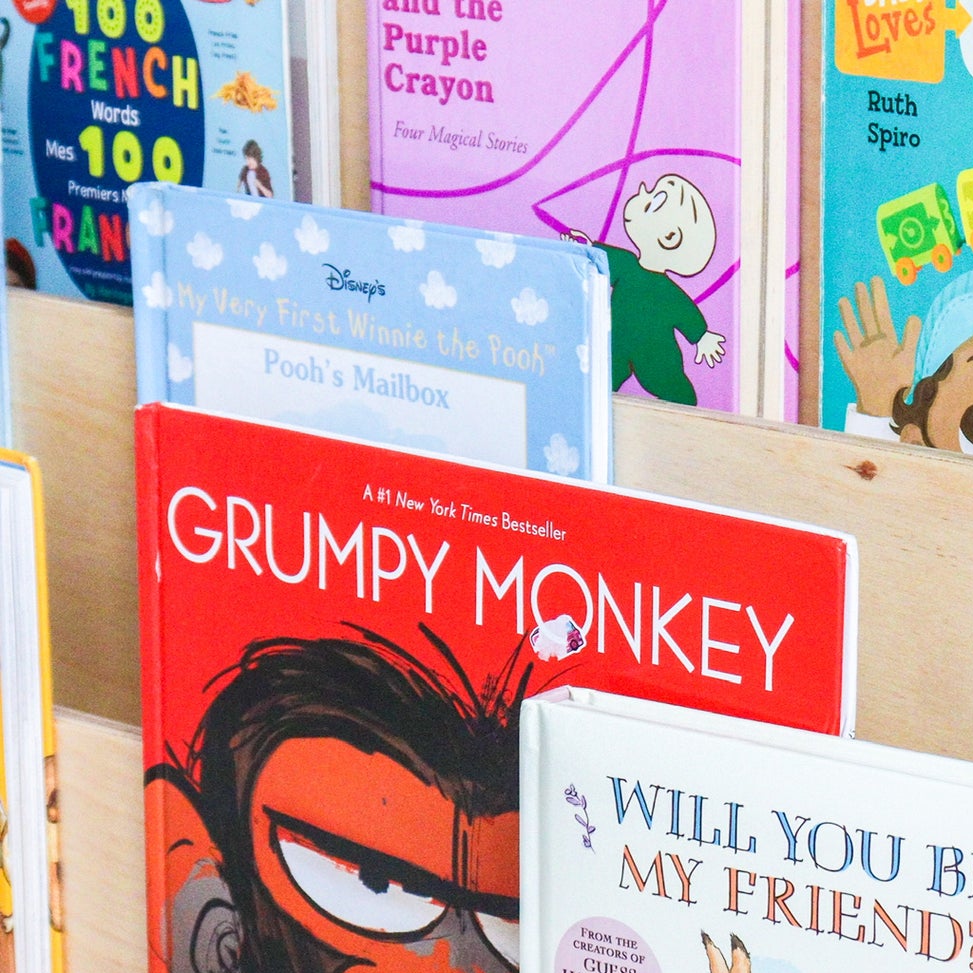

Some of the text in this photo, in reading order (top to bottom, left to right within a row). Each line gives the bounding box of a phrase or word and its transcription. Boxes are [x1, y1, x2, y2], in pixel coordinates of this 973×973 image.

[66, 0, 165, 43] 100
[382, 0, 503, 22] and the
[847, 0, 937, 60] Loves
[383, 22, 488, 66] Purple
[35, 32, 200, 110] FRENCH
[384, 62, 495, 106] Crayon
[90, 99, 141, 127] Words
[867, 90, 918, 117] Ruth
[45, 125, 184, 185] Mes 100
[393, 120, 529, 154] Four Magical Stories
[867, 122, 921, 152] Spiro
[67, 180, 119, 203] Premiers
[29, 196, 132, 262] FRAN
[321, 263, 387, 303] Disney's
[177, 280, 207, 317] My
[213, 287, 268, 327] Very
[275, 297, 342, 336] First
[347, 308, 428, 349] Winnie
[436, 326, 480, 361] the
[263, 347, 450, 410] Pooh's Mailbox
[362, 483, 568, 542] A #1 New York Times Bestseller
[166, 485, 796, 692] GRUMPY MONKEY
[606, 775, 758, 855] WILL
[770, 809, 907, 883] YOU
[618, 843, 704, 908] MY
[573, 939, 647, 966] CREATORS OF
[580, 926, 639, 951] FROM THE
